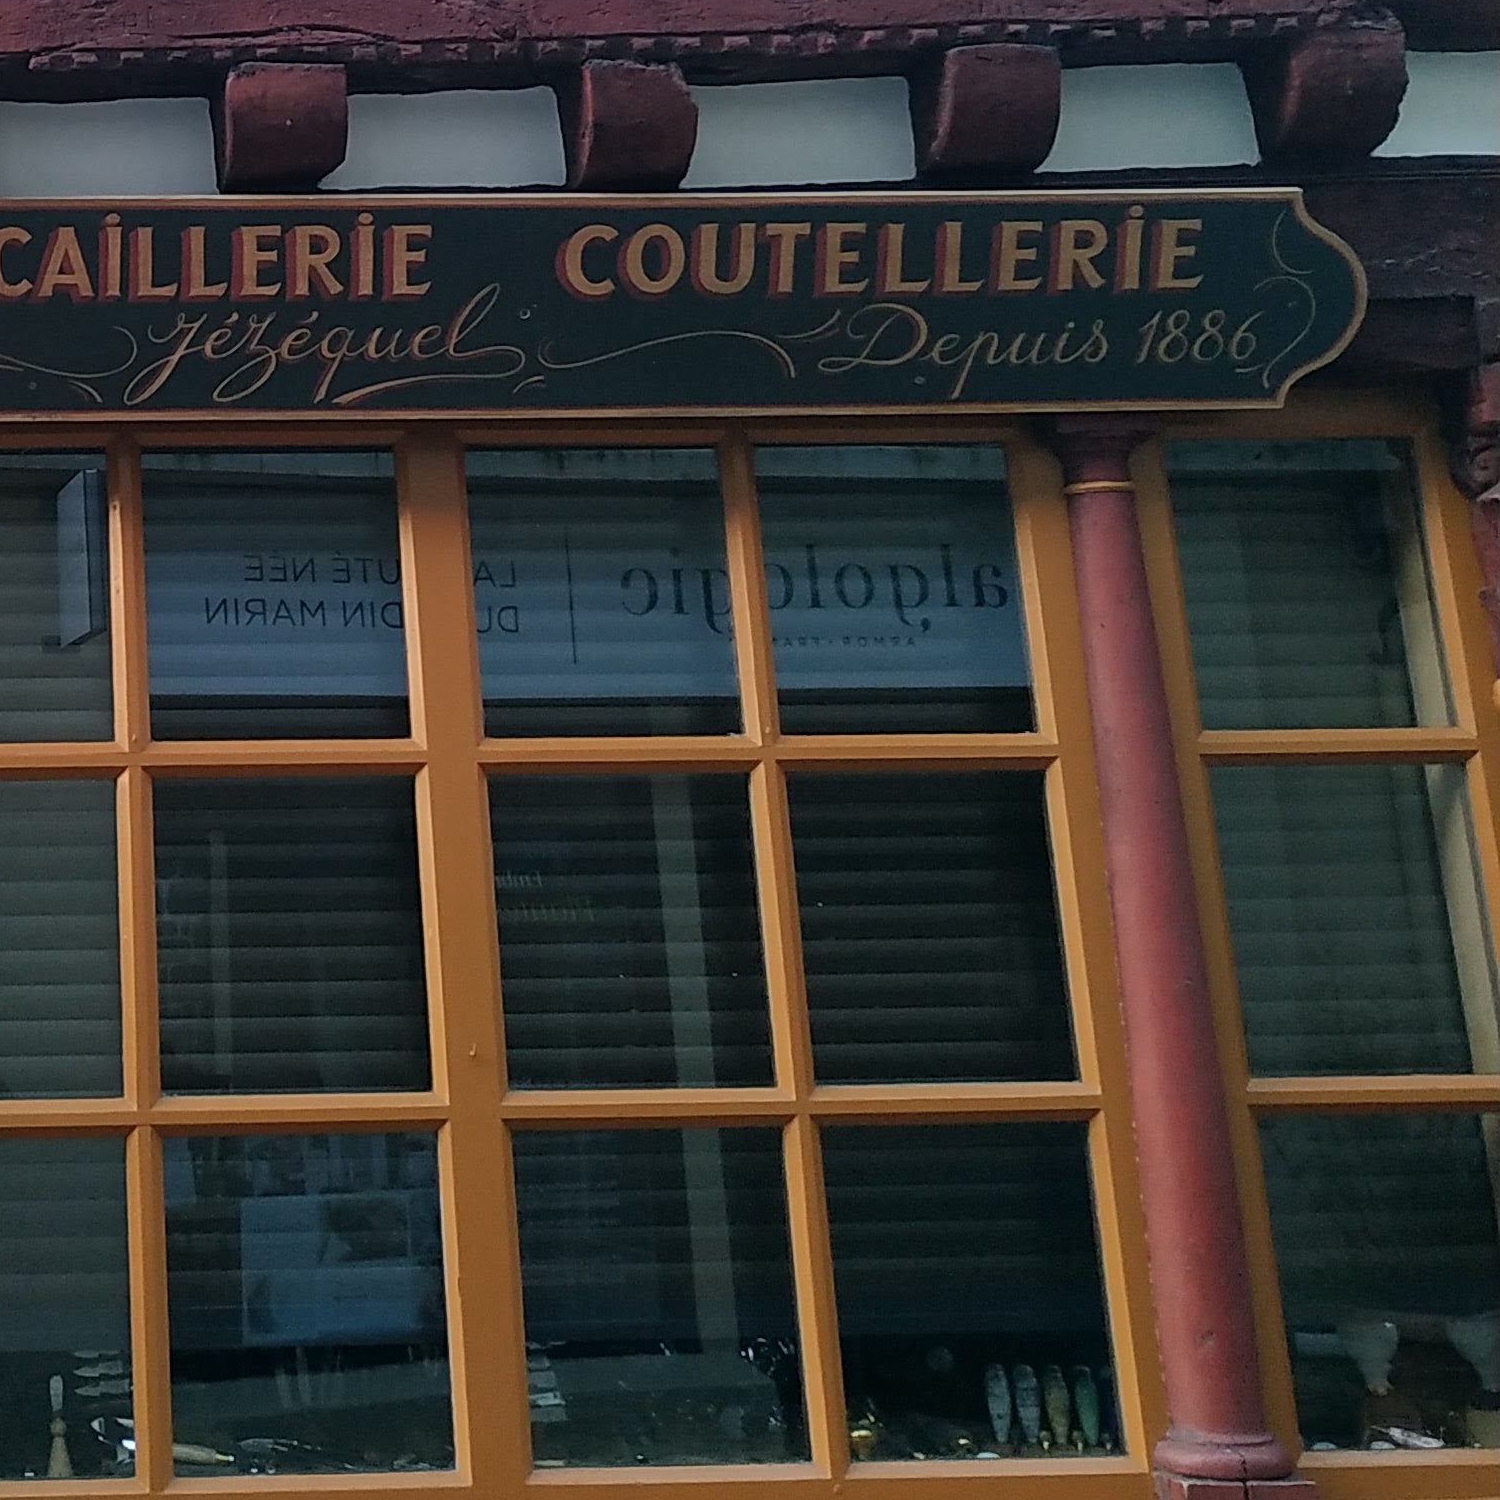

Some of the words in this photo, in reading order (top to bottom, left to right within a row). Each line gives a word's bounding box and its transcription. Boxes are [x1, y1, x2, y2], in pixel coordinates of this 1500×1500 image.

[556, 204, 1204, 298] COUTELLERIE
[124, 284, 500, 405] Jézéquel
[819, 303, 1108, 400] Depuis
[1138, 308, 1265, 364] 1886
